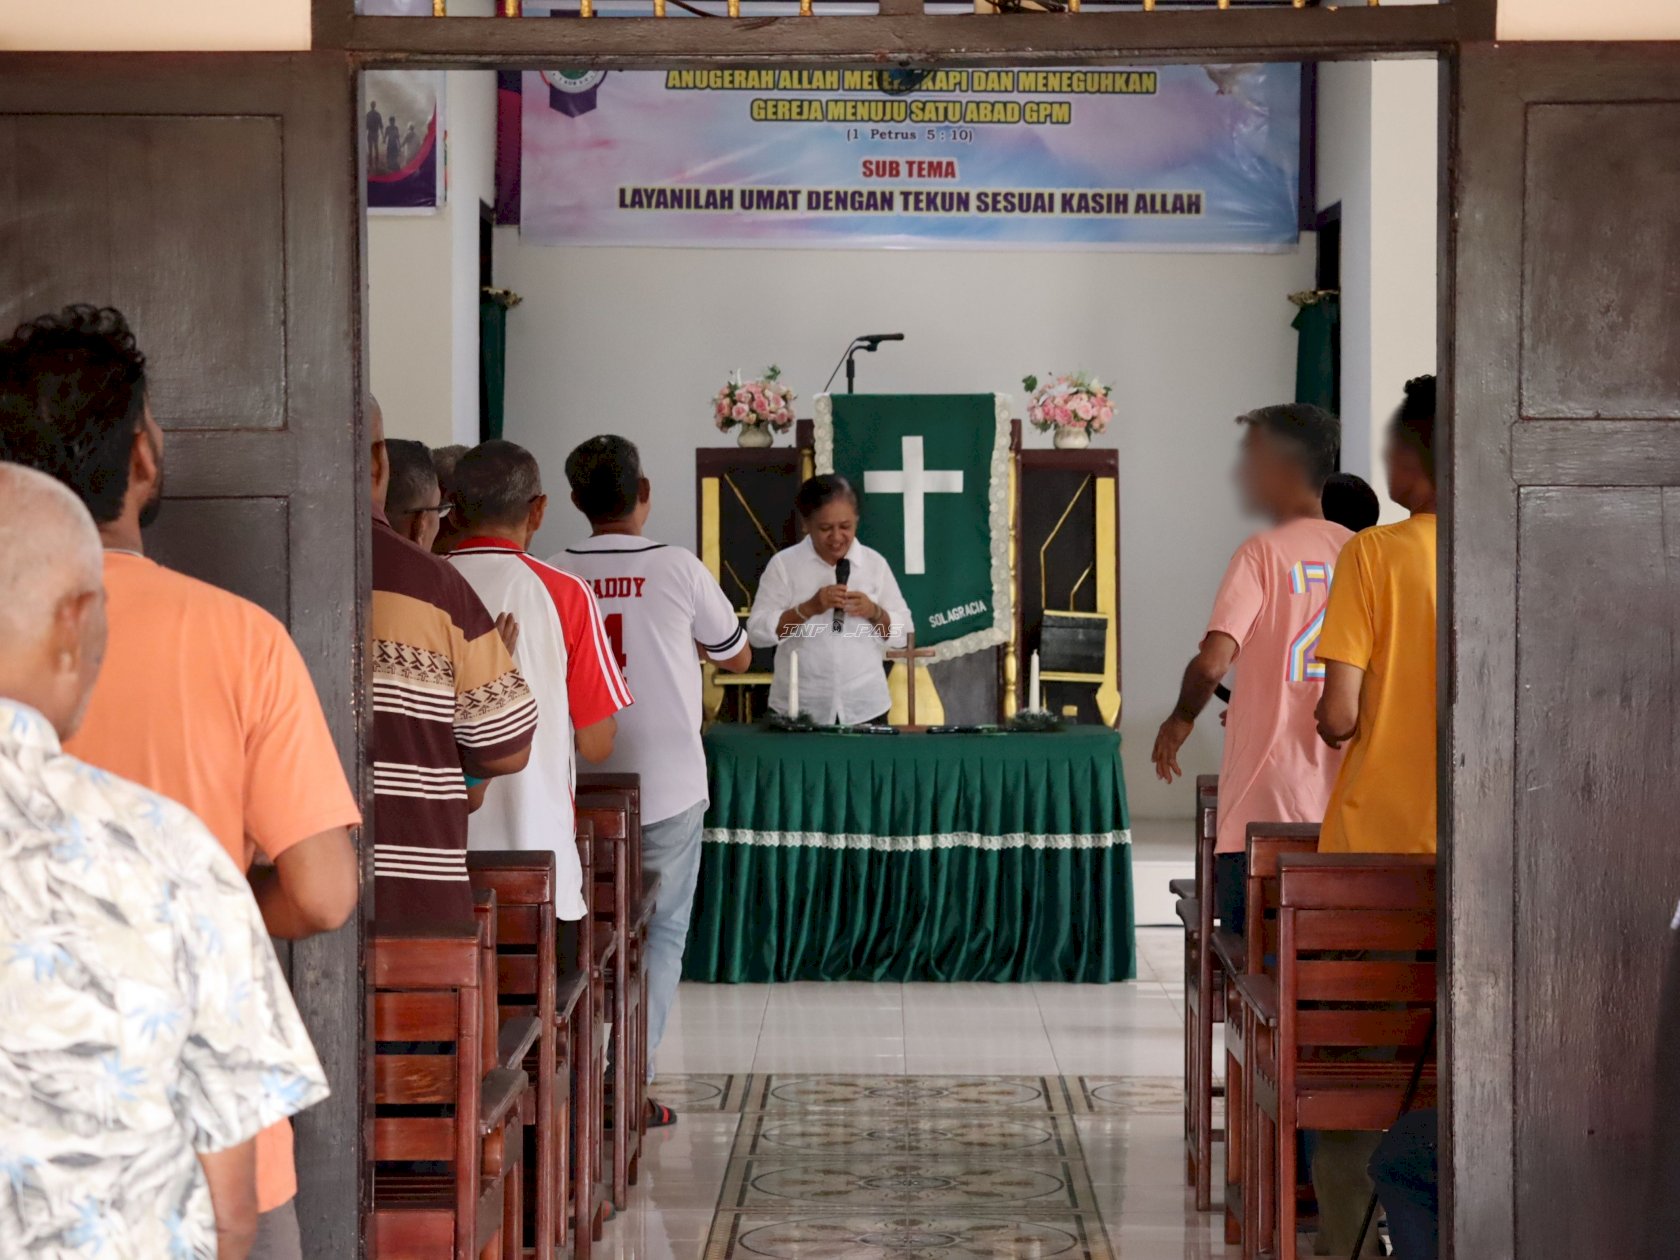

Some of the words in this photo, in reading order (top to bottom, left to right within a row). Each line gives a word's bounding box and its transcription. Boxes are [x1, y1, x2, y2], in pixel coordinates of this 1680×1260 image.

[666, 69, 774, 90] ANUGERAH
[777, 69, 840, 91] ALLAH
[971, 71, 1015, 92] DAN
[1018, 71, 1157, 94] MENEGUHKAN
[751, 99, 823, 121] GEREJA
[826, 99, 907, 122] MENUJU
[909, 100, 962, 123] SATU
[964, 101, 1021, 123] ABAD
[1023, 101, 1071, 124] GPM
[870, 129, 917, 141] Petrus
[862, 159, 901, 178] SUB
[905, 160, 956, 179] TEMA
[618, 187, 734, 210] LAYANILAH
[740, 189, 801, 211] UMAT
[806, 190, 894, 212] DENGAN
[899, 191, 970, 213] TEKUN
[976, 191, 1055, 213] SESUAI
[1060, 192, 1129, 214] KASIH
[1133, 192, 1201, 215] ALLAH
[586, 577, 646, 599] ADDY
